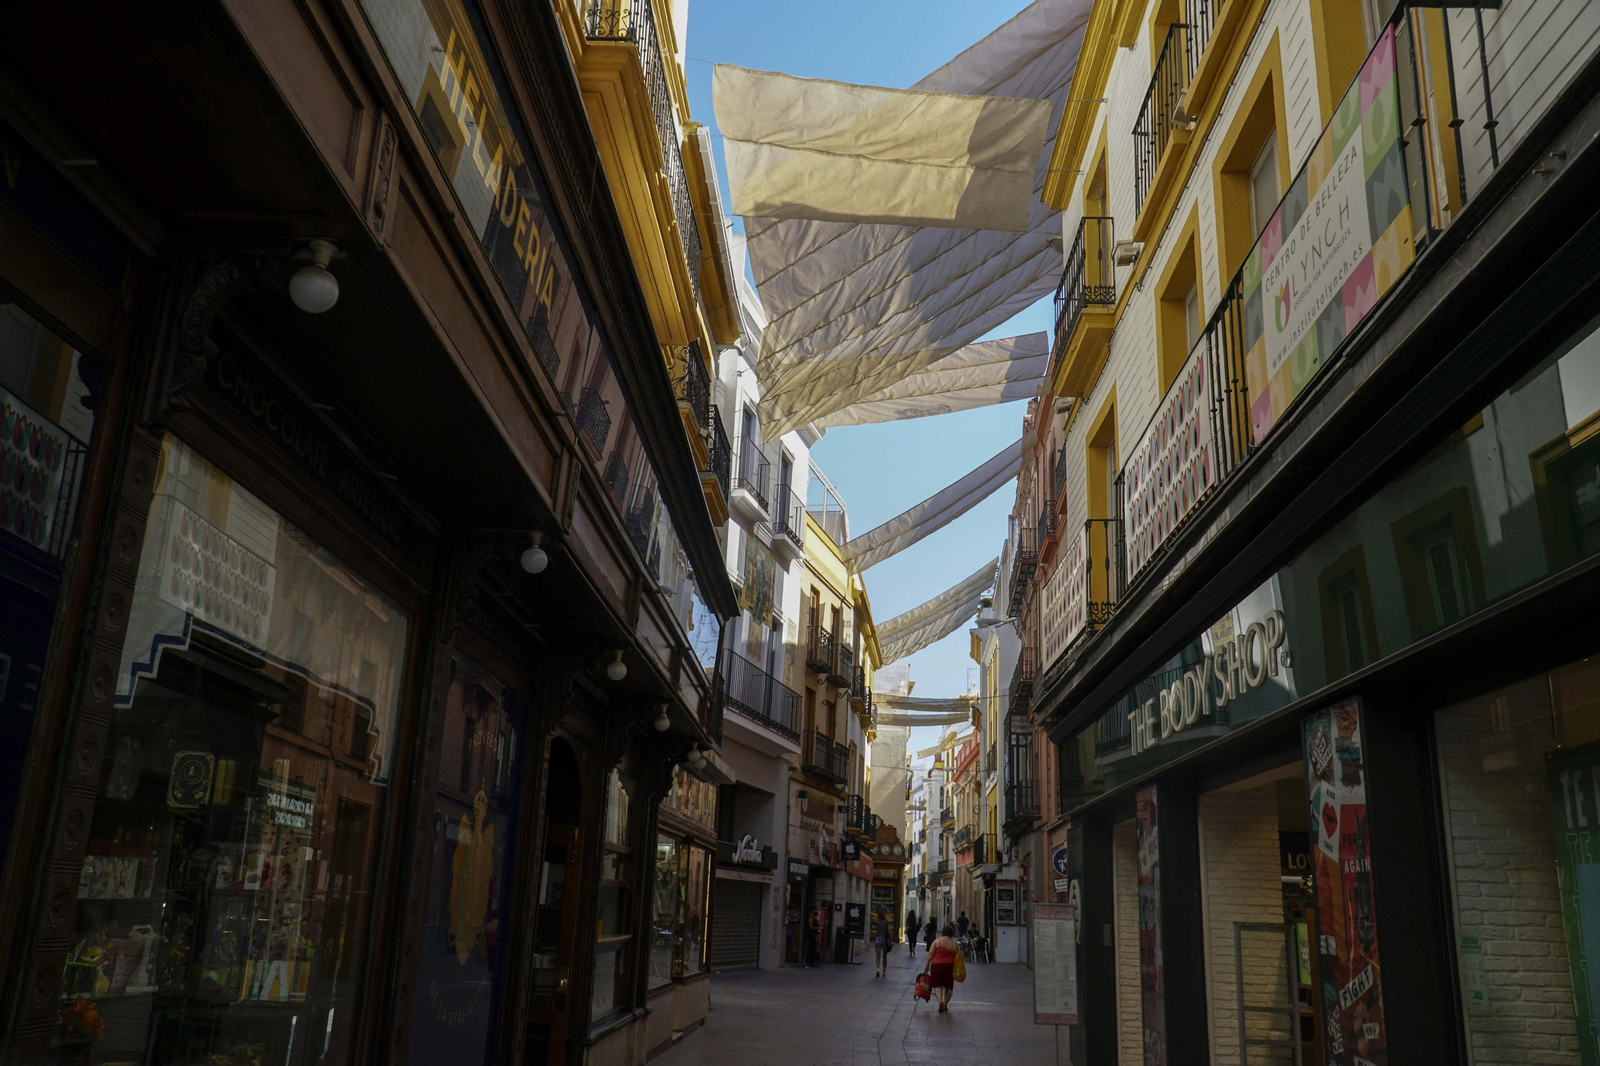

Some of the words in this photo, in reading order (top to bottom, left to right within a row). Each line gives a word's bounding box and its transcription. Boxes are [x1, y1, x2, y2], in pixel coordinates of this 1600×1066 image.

[439, 27, 555, 319] HELADERIA
[1265, 239, 1296, 293] CENTRO
[1300, 214, 1312, 241] DE
[1315, 145, 1358, 217] BELLEZA
[1291, 196, 1350, 298] LYNCH
[1312, 271, 1321, 285] POR
[1321, 228, 1351, 272] NATURALEZA
[1272, 243, 1364, 369] www.institutolynch.es
[218, 353, 328, 477] CHOCOLATE
[1127, 697, 1158, 756] THE
[1160, 656, 1211, 739] BODY
[1214, 609, 1285, 707] SHOP
[1326, 789, 1336, 800] KISS
[1560, 769, 1588, 828] TE
[1323, 840, 1333, 853] THIS
[1344, 858, 1371, 874] AGAIN
[1341, 969, 1373, 1007] FIGHT
